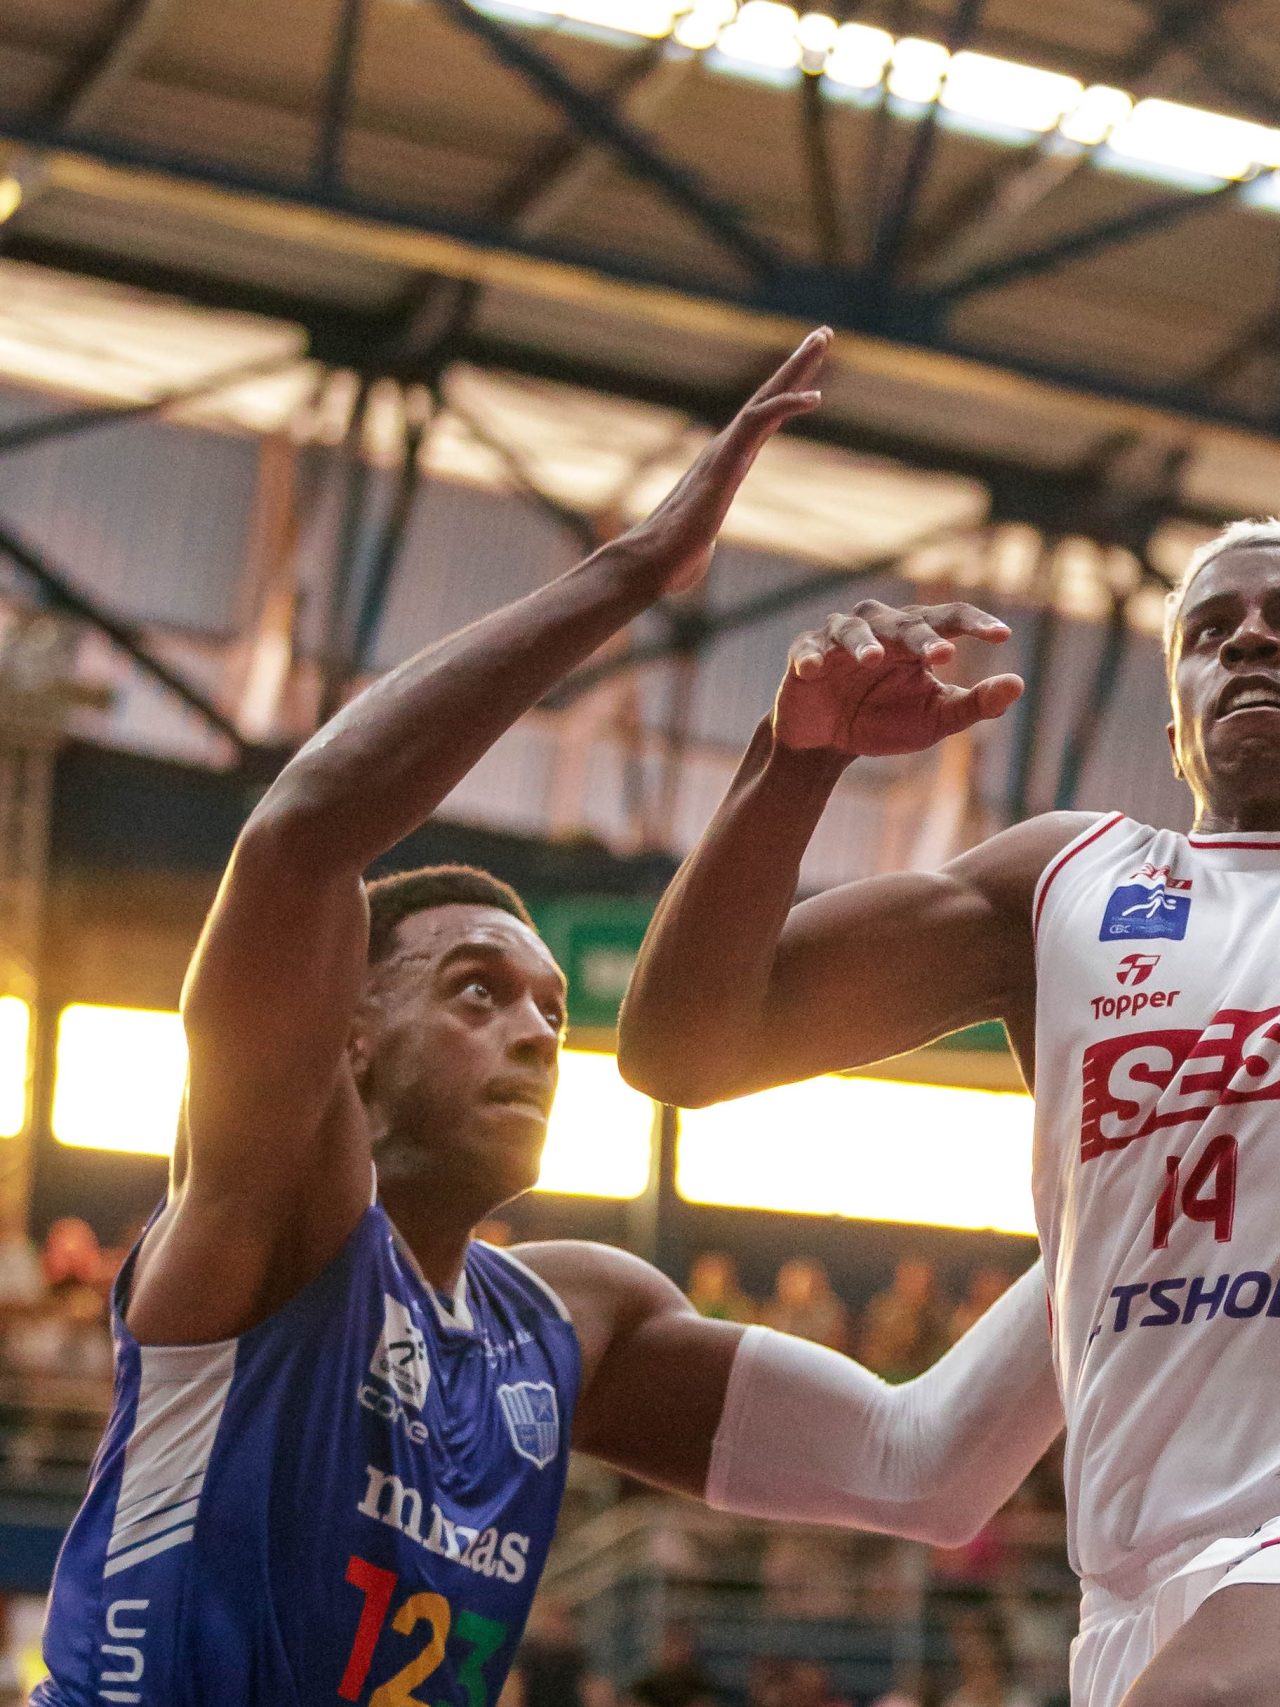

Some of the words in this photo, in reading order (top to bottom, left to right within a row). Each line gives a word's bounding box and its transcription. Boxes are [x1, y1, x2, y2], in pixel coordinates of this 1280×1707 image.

[1090, 990, 1180, 1020] Topper
[1152, 1134, 1238, 1249] 14
[357, 1464, 530, 1584] minas
